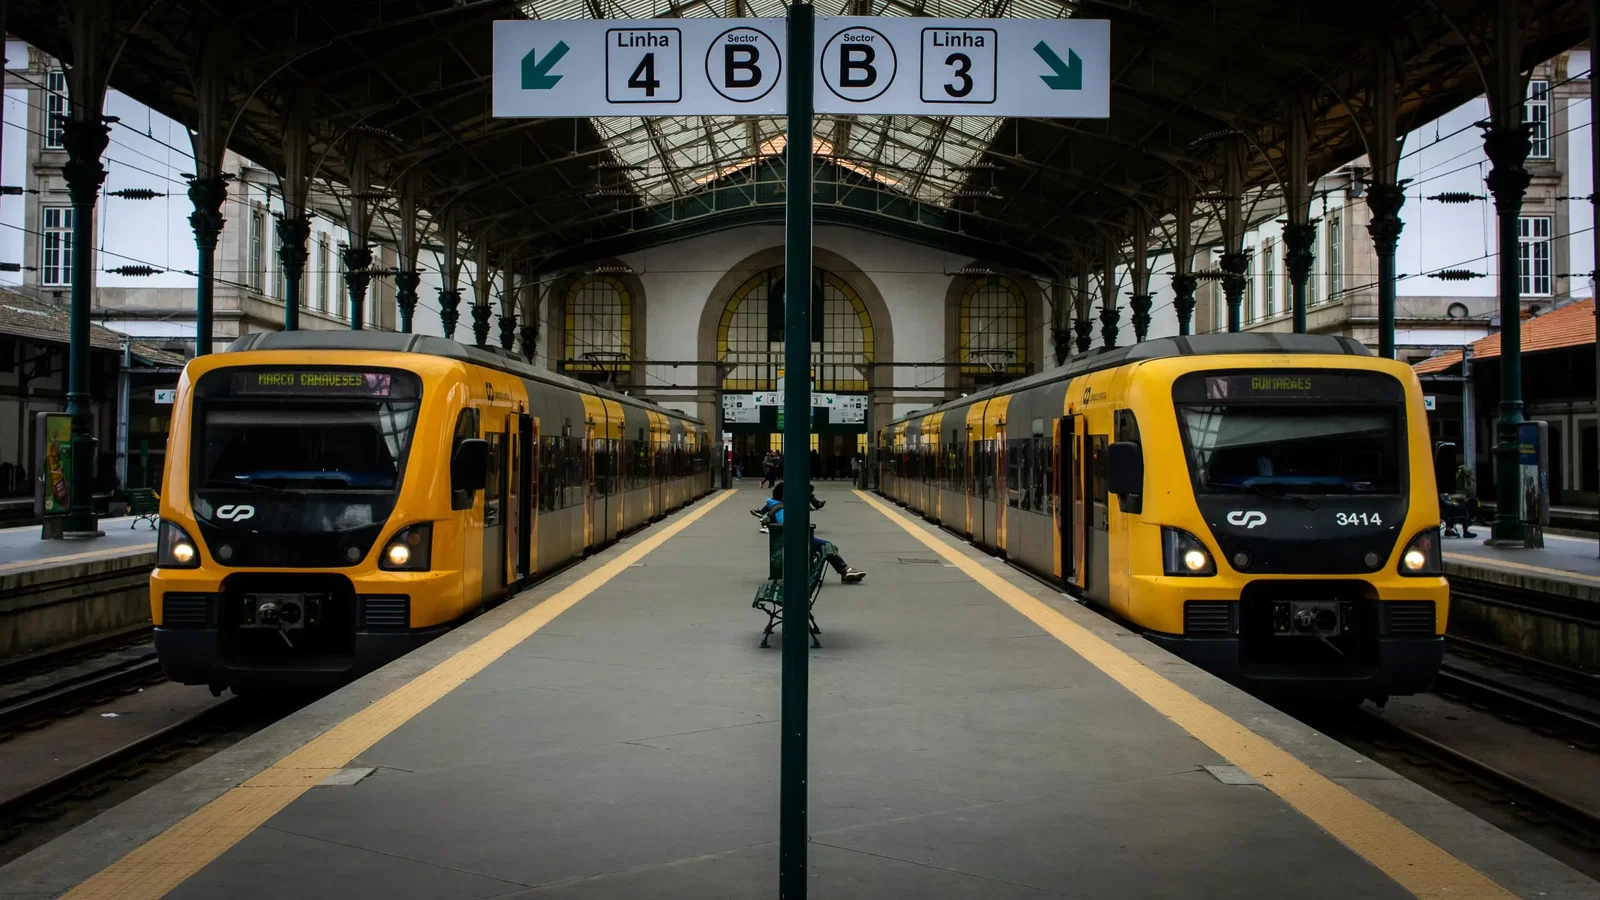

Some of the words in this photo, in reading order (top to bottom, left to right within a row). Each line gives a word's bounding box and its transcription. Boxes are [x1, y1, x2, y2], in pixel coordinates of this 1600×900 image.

[617, 32, 669, 48] Linha
[727, 33, 759, 43] Sector
[843, 33, 875, 43] Sector
[933, 32, 985, 48] Linha
[724, 44, 763, 88] B
[839, 44, 878, 88] B
[627, 52, 660, 97] 4
[943, 52, 974, 98] 3
[258, 374, 295, 386] MARCO
[770, 396, 775, 404] 4
[813, 397, 819, 405] 3
[1336, 513, 1383, 527] 3414
